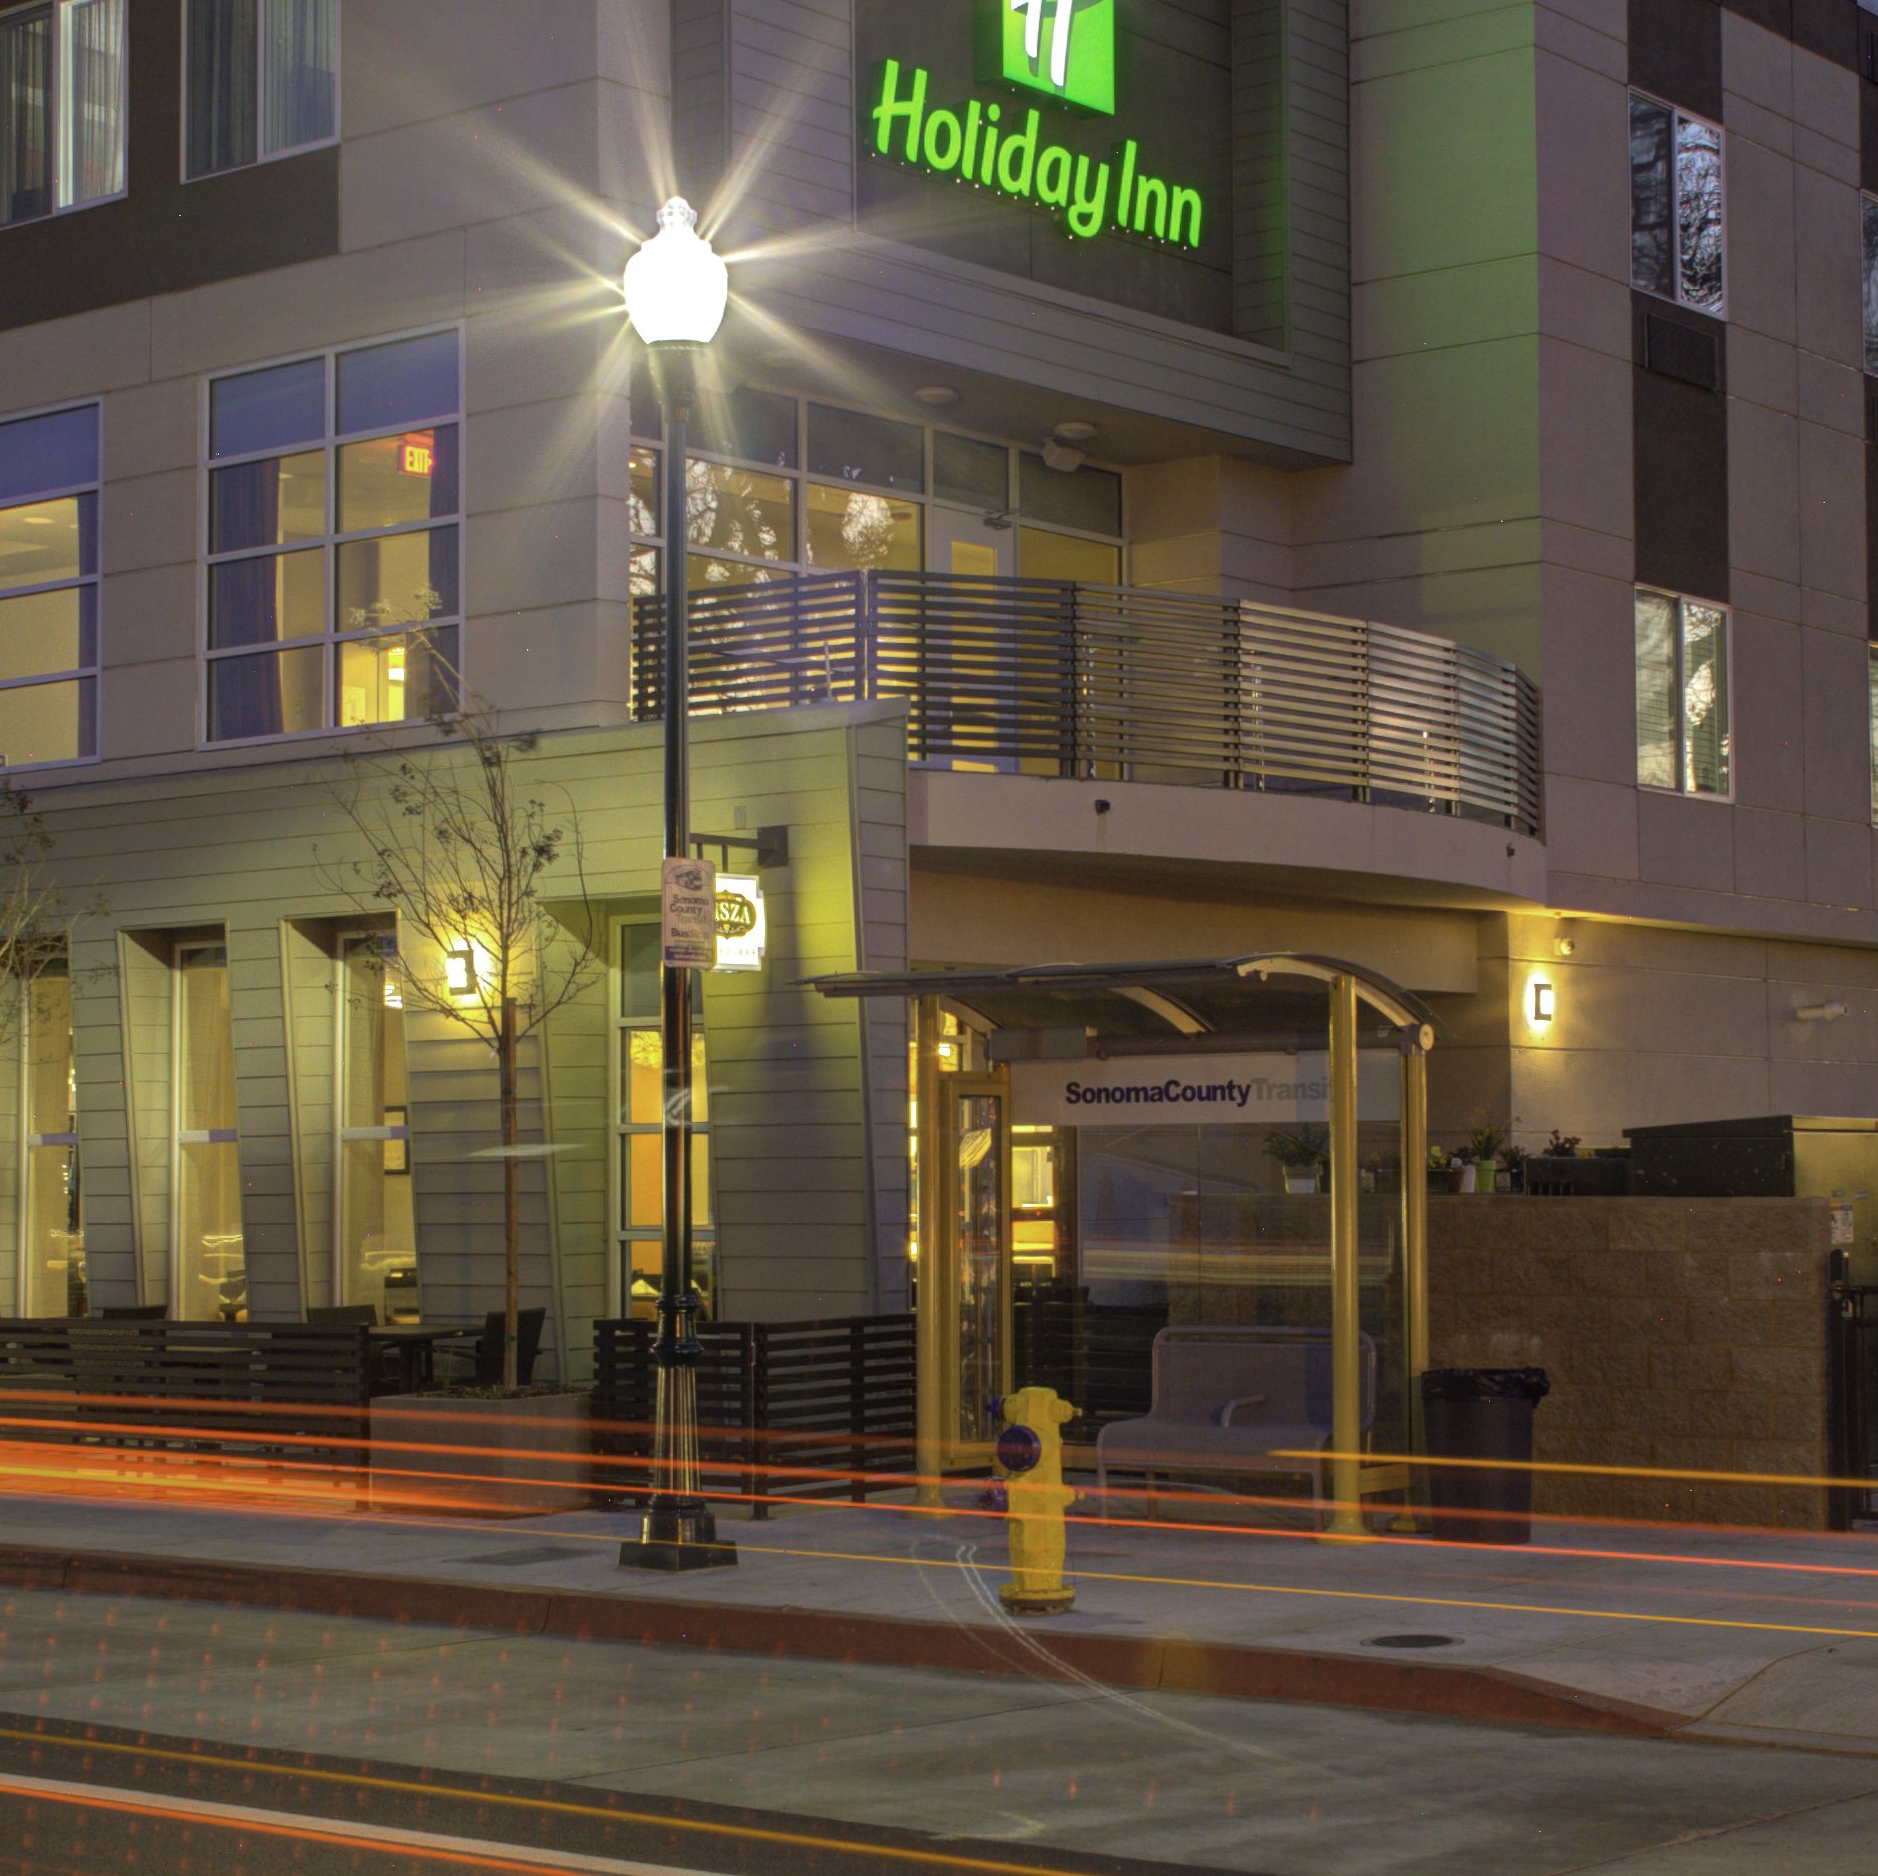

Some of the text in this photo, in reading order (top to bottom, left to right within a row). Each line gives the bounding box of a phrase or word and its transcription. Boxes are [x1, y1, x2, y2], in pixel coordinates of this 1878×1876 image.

[873, 58, 1203, 249] Holiday Inn
[673, 893, 710, 906] Sonoma
[670, 903, 703, 917] County
[715, 901, 751, 924] ISZA
